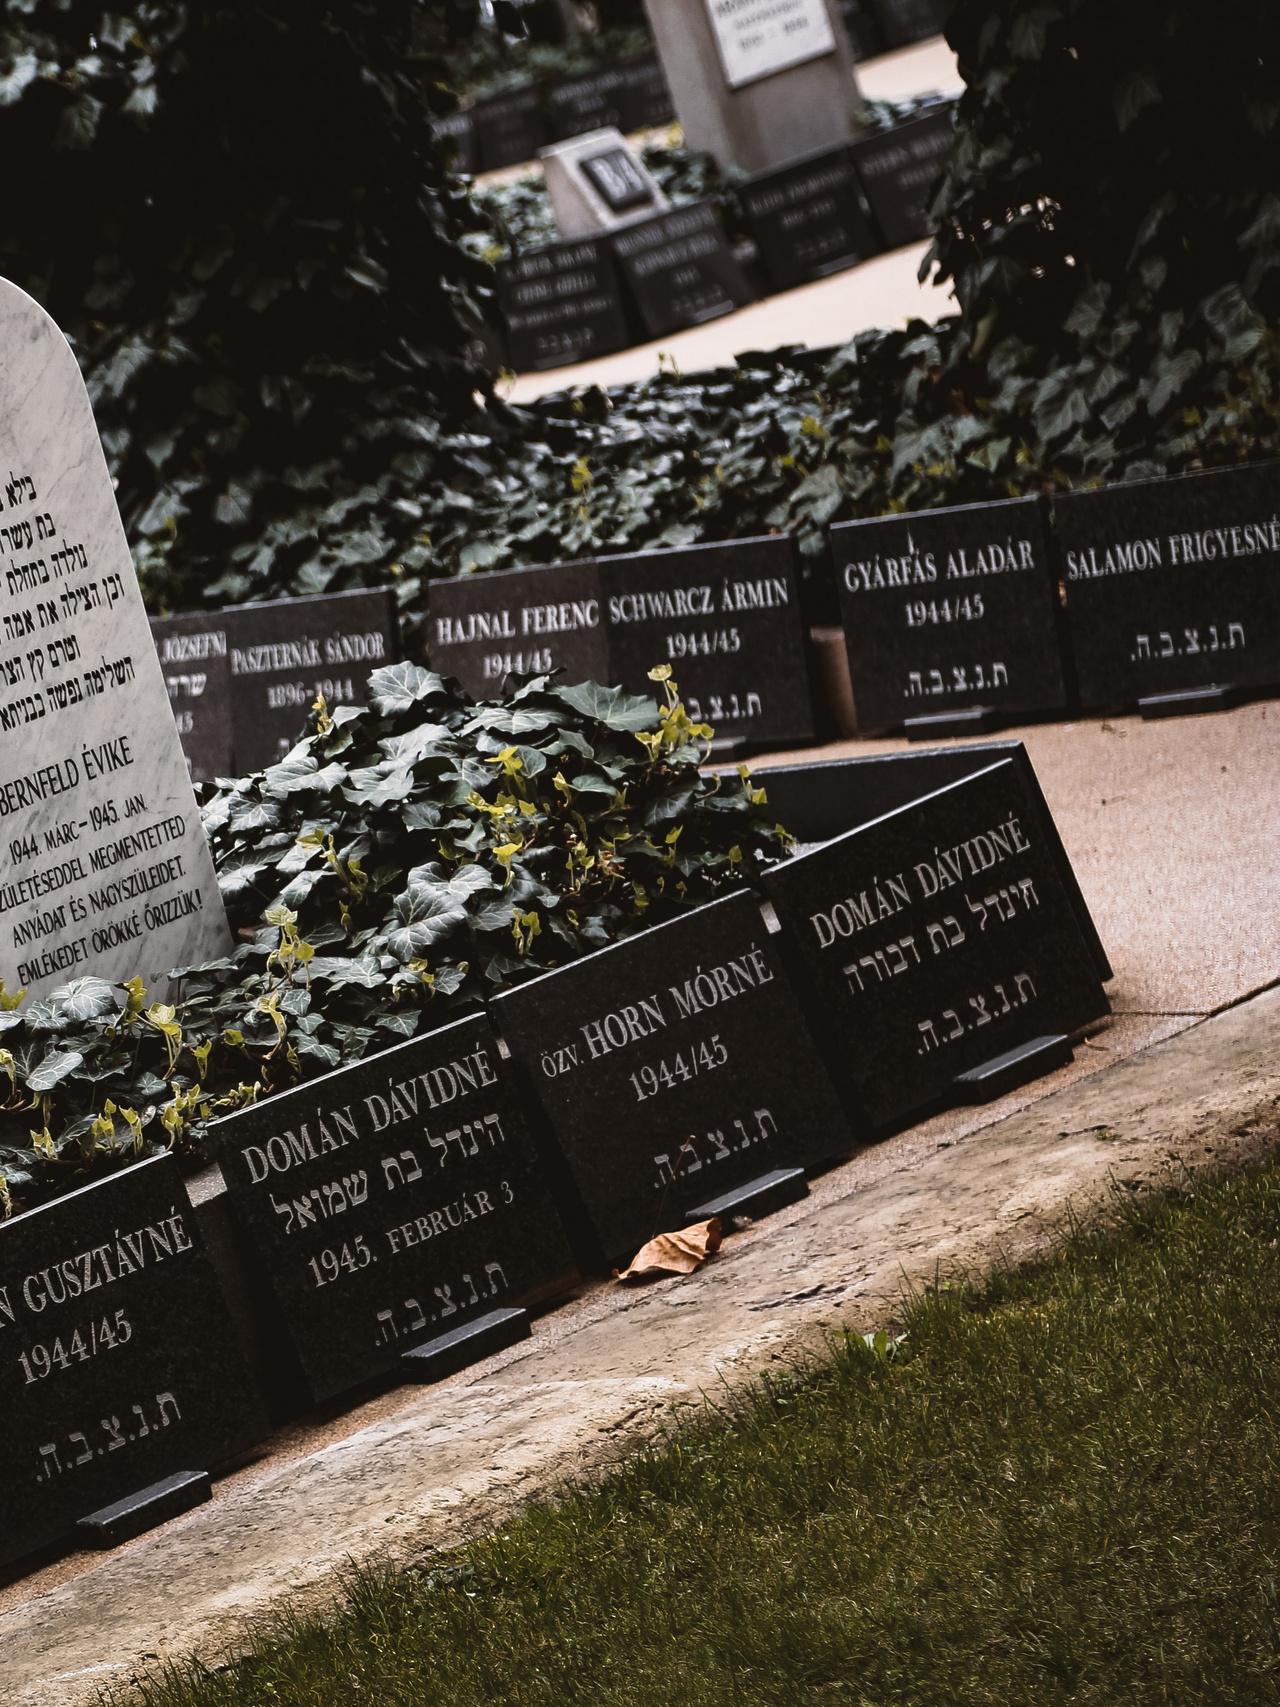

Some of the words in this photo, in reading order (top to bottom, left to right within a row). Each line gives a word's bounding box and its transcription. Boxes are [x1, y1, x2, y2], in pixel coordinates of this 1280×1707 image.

[5, 471, 36, 507] בילא
[35, 513, 56, 540] בת
[6, 559, 50, 596] בתחלת
[51, 539, 88, 578] נולדה
[946, 535, 1035, 580] ALADÁR
[1067, 537, 1162, 581] SALAMON
[37, 600, 59, 628] את
[60, 582, 101, 618] הצילה
[609, 586, 715, 625] SCHWARCZ
[721, 577, 789, 613] ÁRMIN
[905, 593, 985, 627] 1944/45
[3, 609, 35, 641] אמה
[436, 609, 516, 646] HAJNAL
[521, 599, 600, 636] FERENC
[666, 627, 741, 659] 1944/45
[26, 648, 44, 683] קץ
[47, 635, 80, 668] וטרם
[46, 678, 83, 712] נפשה
[84, 655, 135, 697] השלימה
[82, 736, 134, 780] ÉVIKE
[9, 834, 42, 865] 1944.
[124, 794, 148, 818] JAN.
[89, 815, 186, 873] MEGMENTETTED
[810, 873, 912, 949] DOMÁN
[914, 811, 1031, 898] DÁVIDNÉ
[13, 905, 66, 948] ANYÁDAT
[69, 895, 87, 922] ÉS
[926, 915, 966, 955] בת
[17, 938, 88, 986] EMLÉKEDET
[92, 910, 142, 953] ÖRÖKKÉ
[843, 935, 921, 995] דבורה
[541, 1044, 584, 1078] ÖZV.
[580, 994, 667, 1060] HORN
[669, 942, 774, 1019] MÓRNÉ
[629, 1034, 728, 1102] 1944/45
[241, 1105, 360, 1184] DOMÁN
[364, 1042, 498, 1132] DÁVIDNÉ
[424, 1113, 505, 1167] הינדל
[380, 1150, 423, 1190] בת
[270, 1170, 368, 1235] שמואל
[308, 1235, 378, 1288] 1945.
[385, 1192, 495, 1254] FEBRUÁR
[500, 1181, 514, 1205] 3
[22, 1206, 193, 1313] GUSZTÁVNÉ
[18, 1309, 132, 1385] 1944/45
